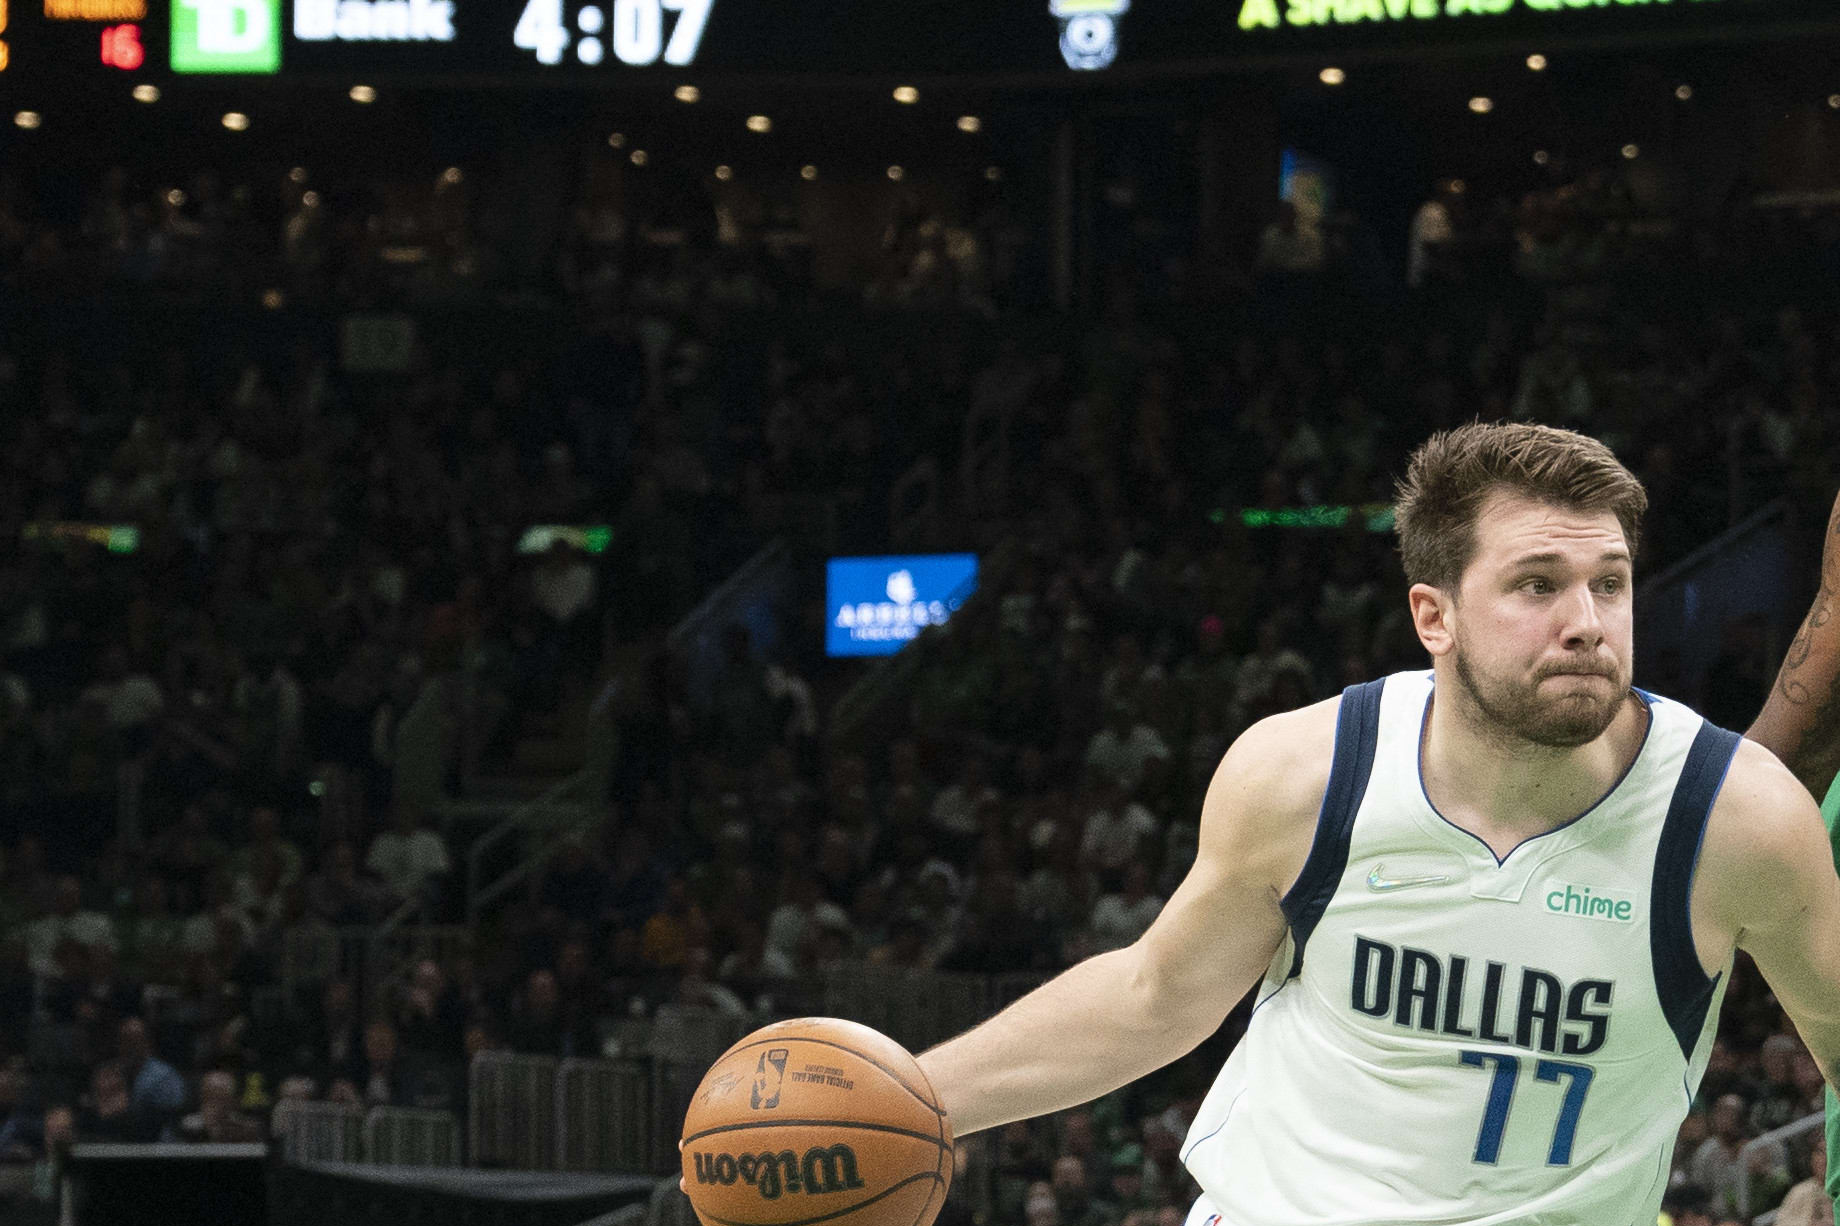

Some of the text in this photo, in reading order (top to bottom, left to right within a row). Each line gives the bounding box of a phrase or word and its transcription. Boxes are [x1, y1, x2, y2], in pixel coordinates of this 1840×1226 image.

[513, 0, 715, 66] 4:07
[1546, 884, 1632, 922] chime
[1350, 933, 1616, 1057] DALLAS
[1458, 1049, 1597, 1168] 77
[693, 1143, 865, 1200] Wilson
